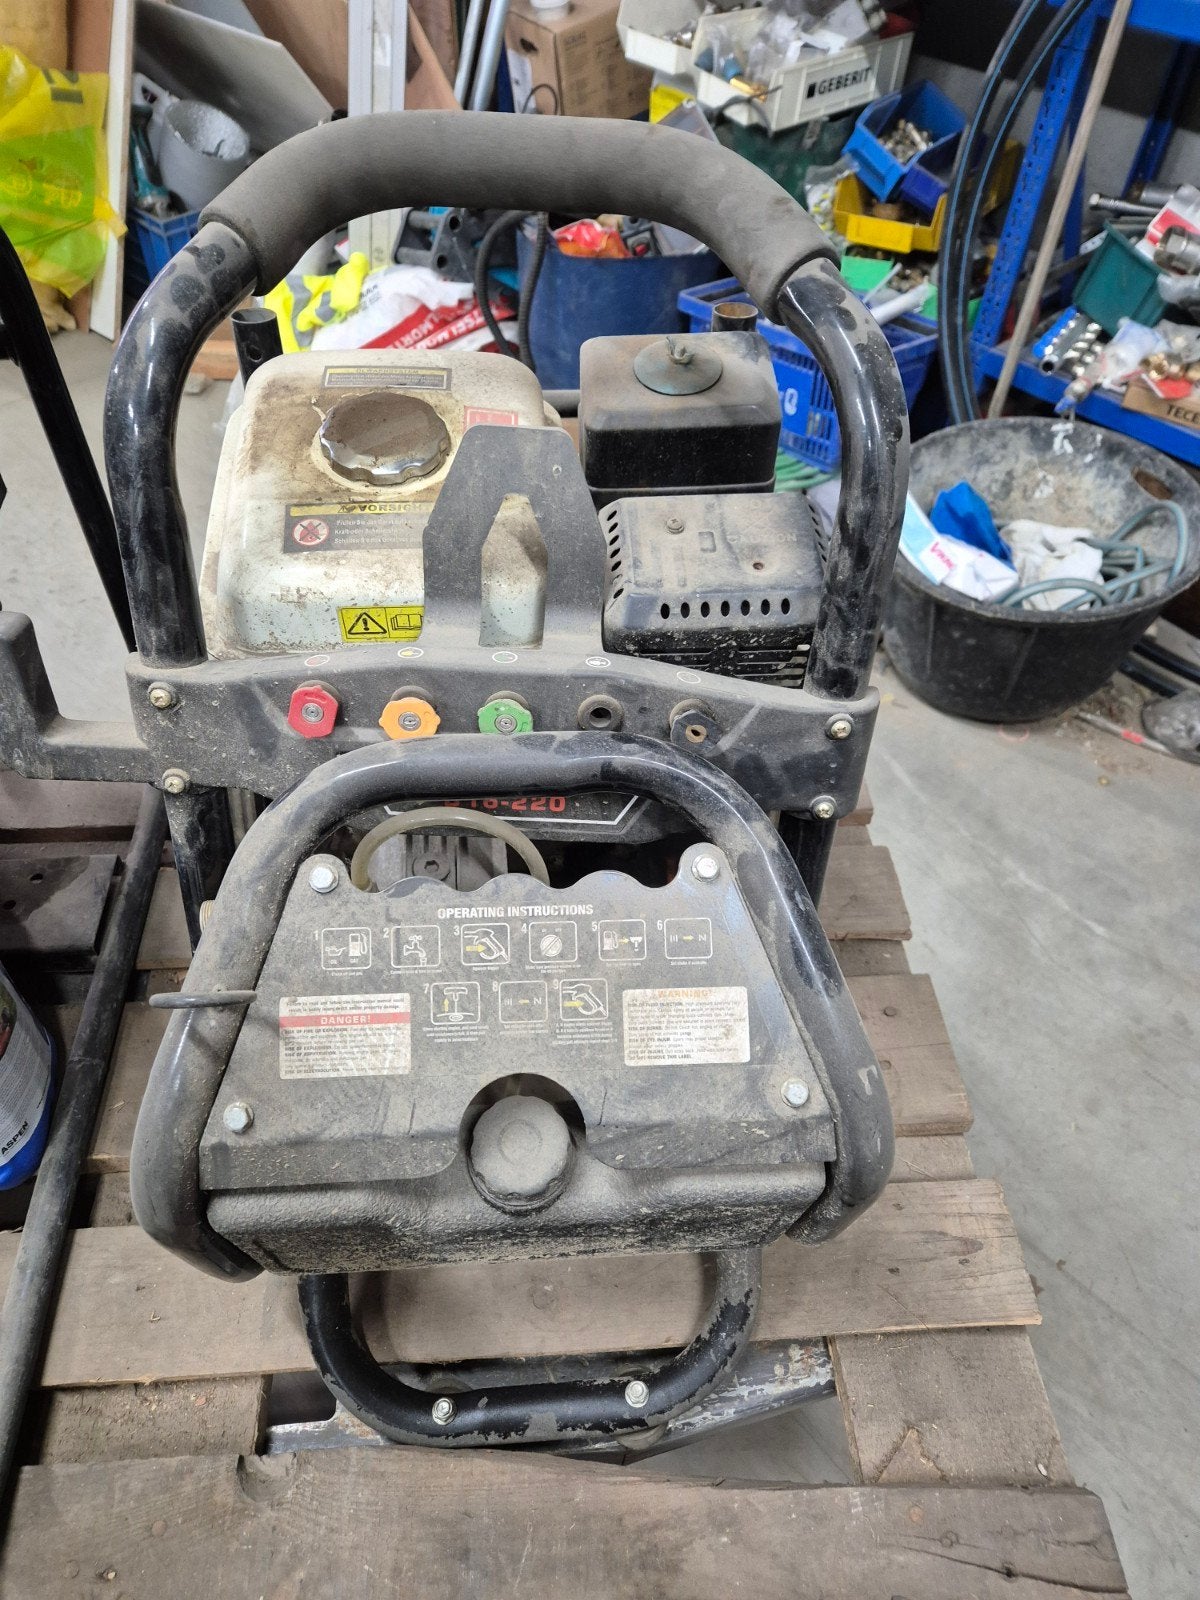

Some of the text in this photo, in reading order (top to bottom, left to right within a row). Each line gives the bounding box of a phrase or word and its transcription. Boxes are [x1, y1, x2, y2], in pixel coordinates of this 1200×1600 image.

[818, 66, 872, 94] GEBERIT
[437, 904, 594, 919] OPERATING INSTRUCTIONS
[453, 925, 460, 936] 3
[521, 923, 527, 933] 4
[592, 920, 598, 931] 5
[657, 919, 663, 931] 6
[313, 930, 319, 941] 1
[383, 927, 390, 939] 2
[423, 983, 429, 994] 7
[493, 981, 499, 992] 8
[553, 979, 559, 990] 9
[320, 1014, 371, 1025] DANGER!
[1, 1120, 28, 1154] ASPEN
